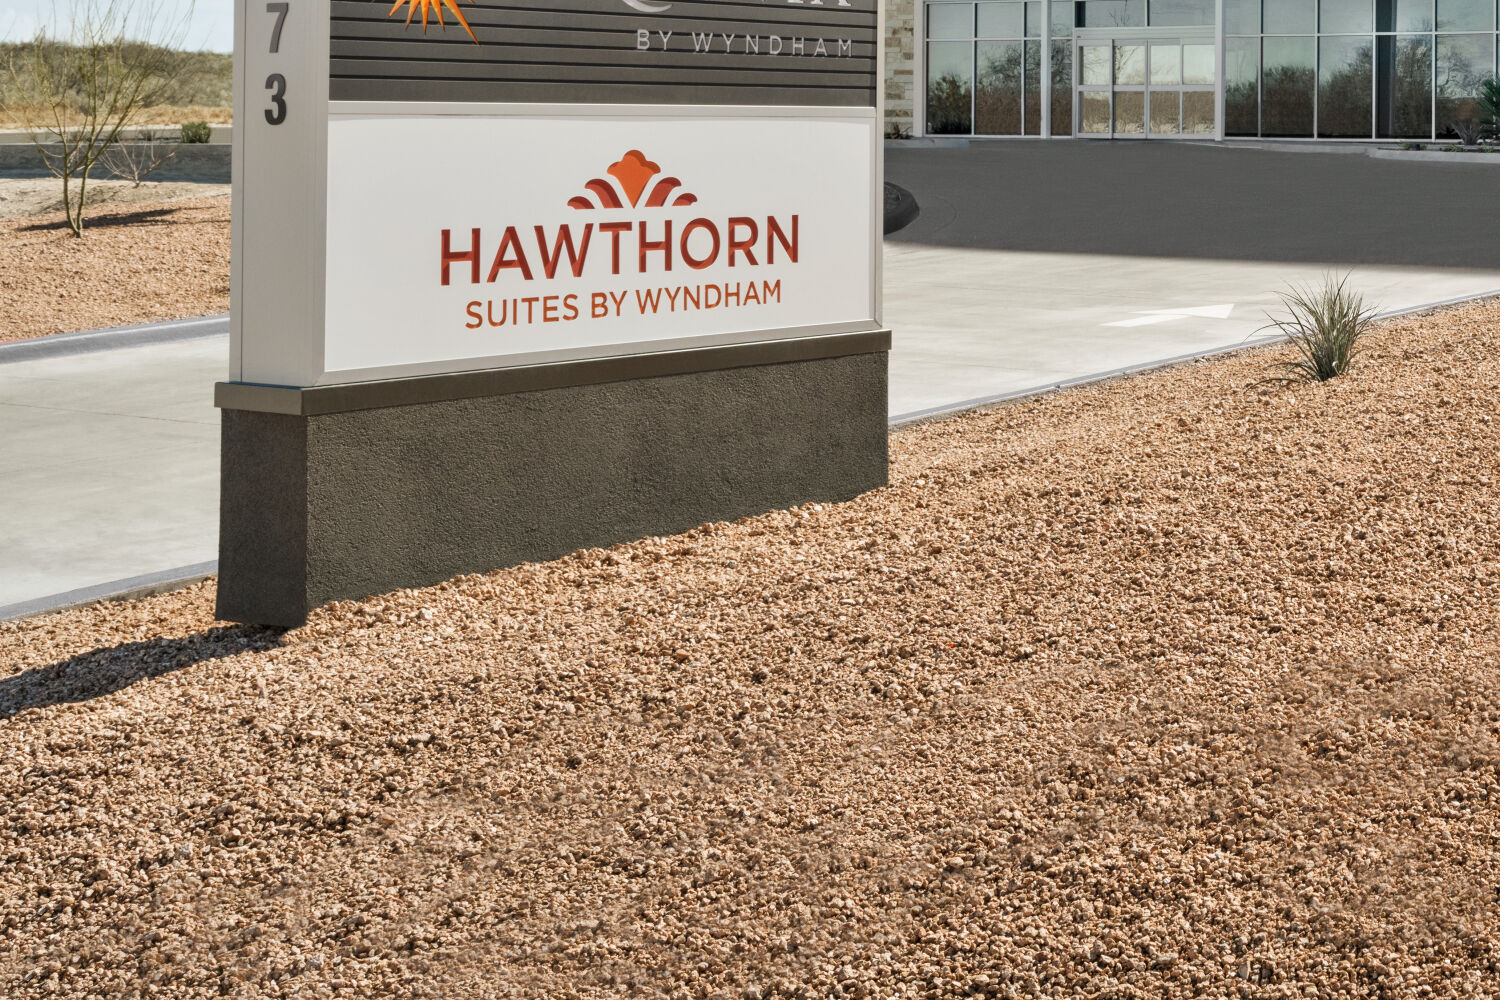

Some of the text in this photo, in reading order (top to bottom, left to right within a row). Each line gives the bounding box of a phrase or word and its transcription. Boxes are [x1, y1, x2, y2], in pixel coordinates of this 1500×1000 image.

[636, 29, 852, 58] BY WYNDHAM
[441, 214, 799, 286] HAWTHORN
[465, 279, 782, 329] SUITES BY WYNDHAM
